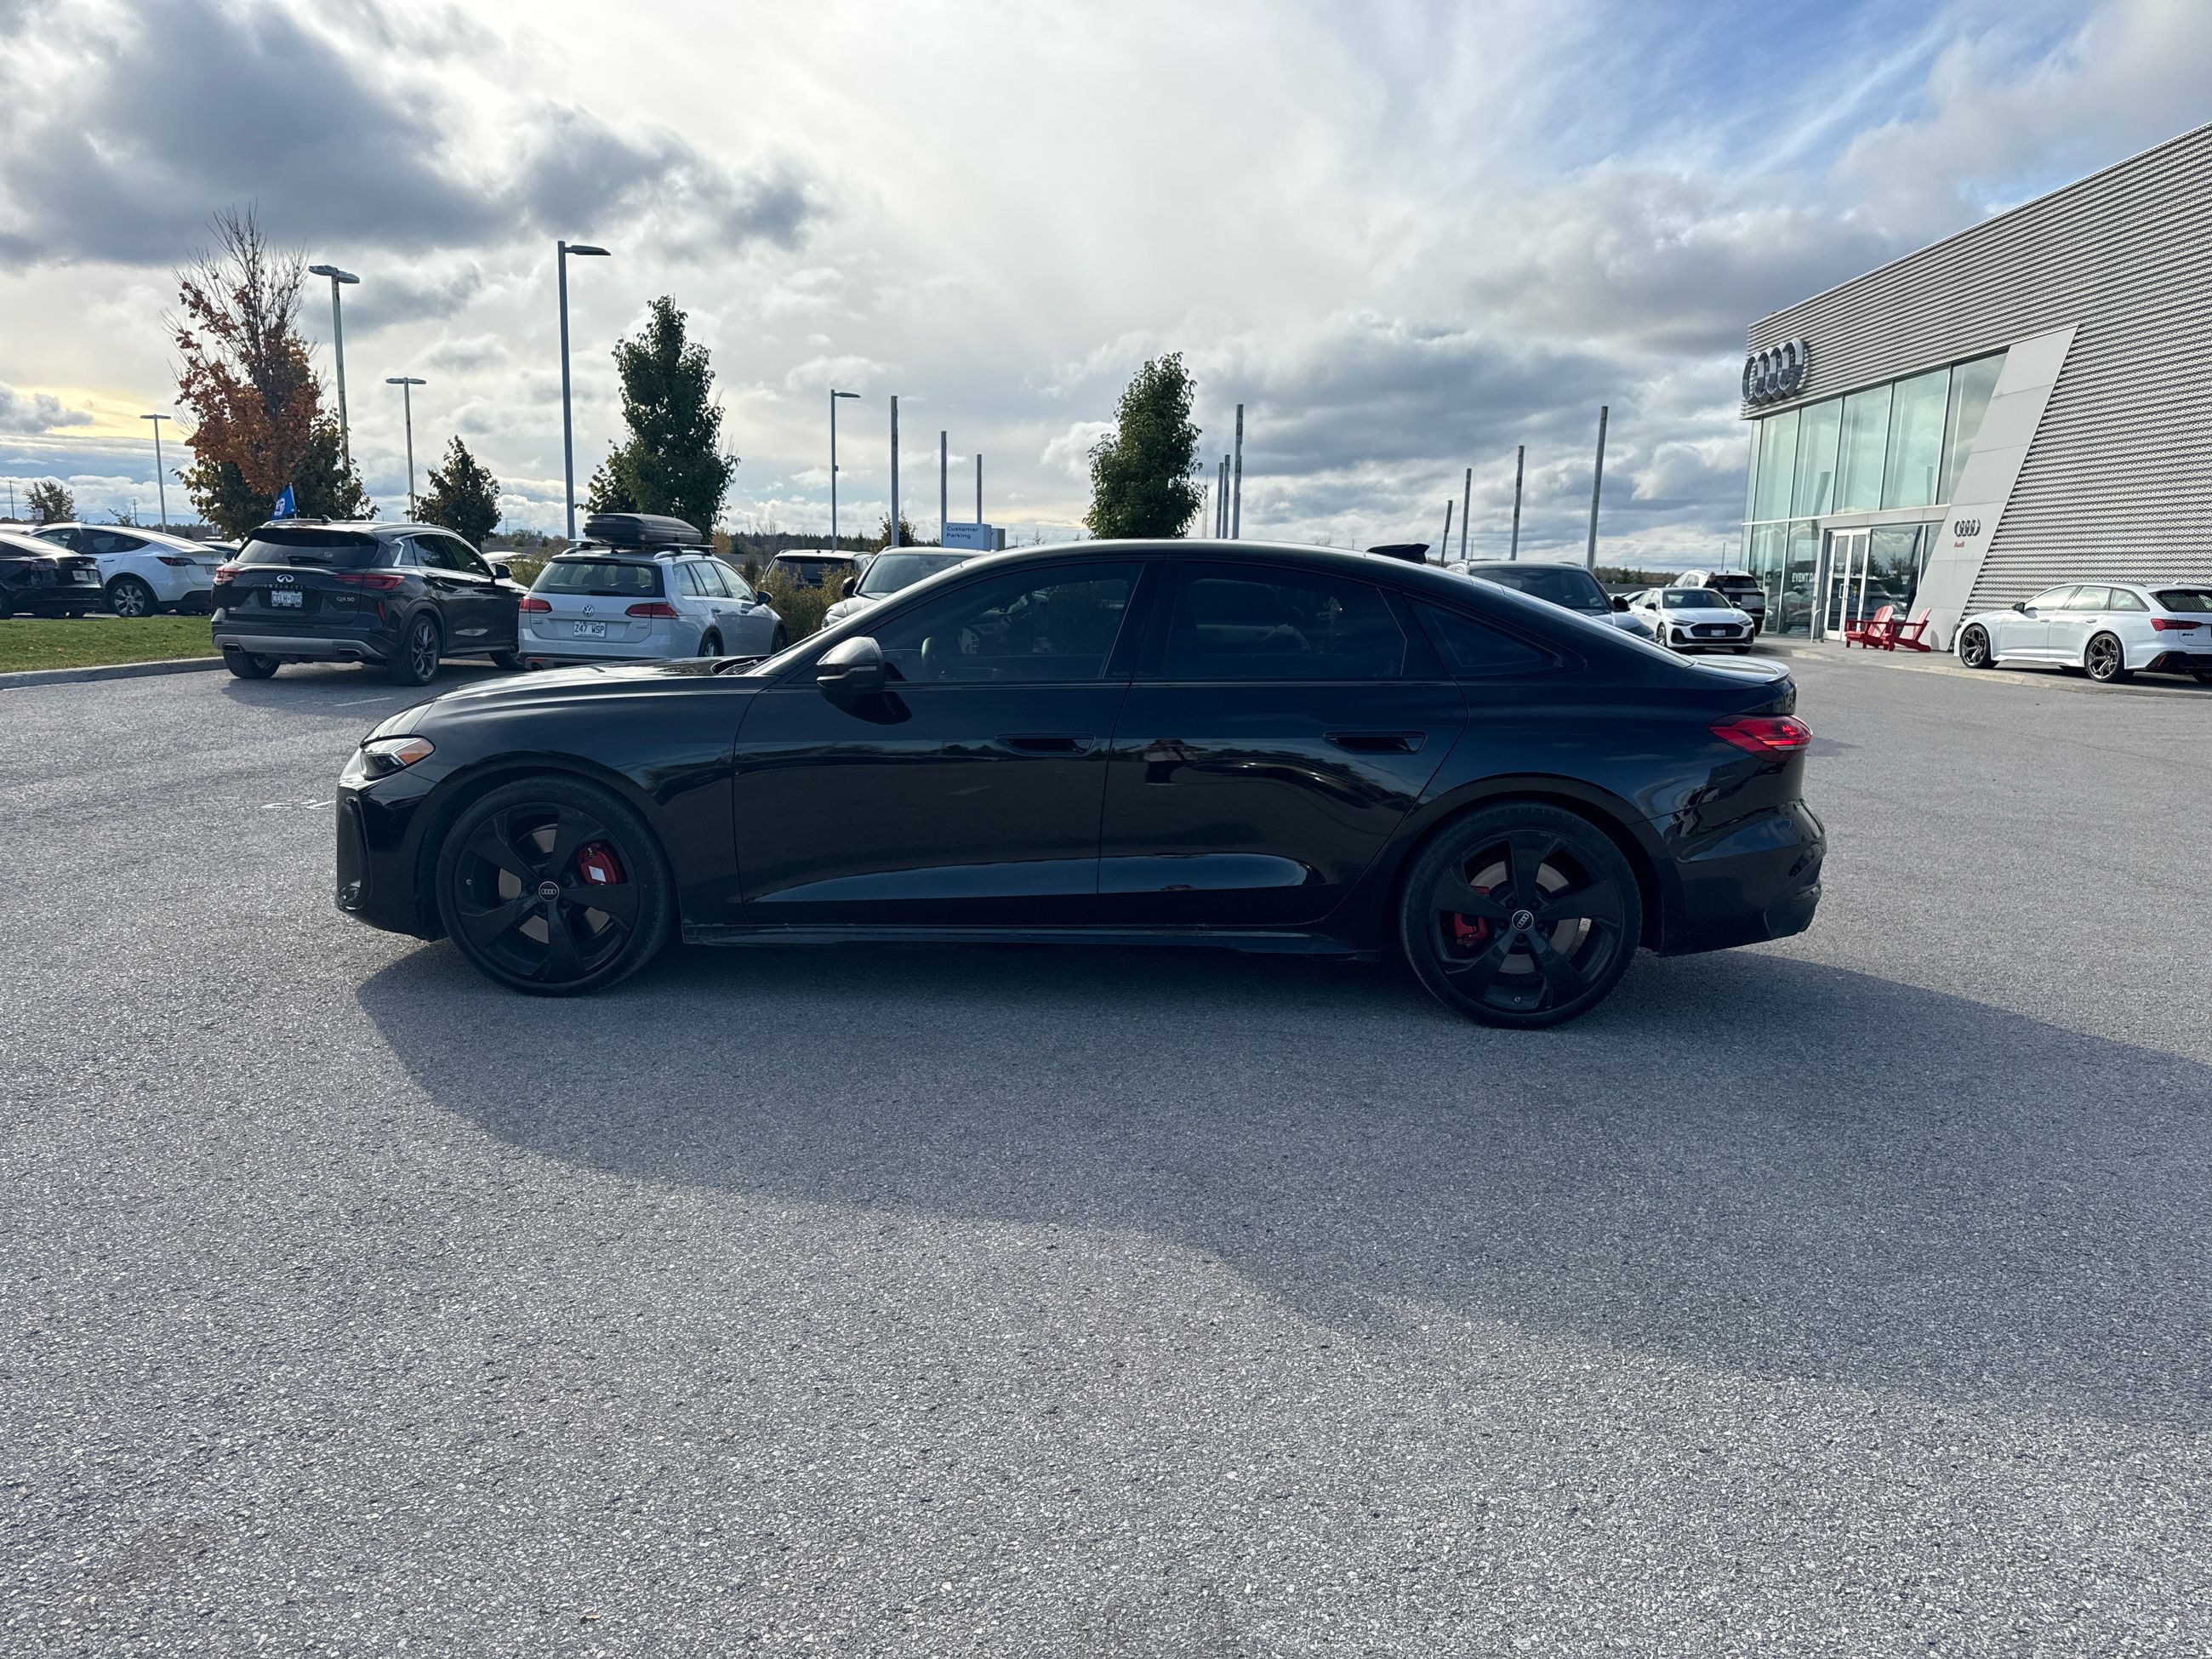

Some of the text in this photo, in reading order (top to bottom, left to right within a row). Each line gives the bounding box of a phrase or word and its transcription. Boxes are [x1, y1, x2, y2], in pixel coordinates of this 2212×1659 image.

[1791, 572, 1810, 583] EVENT
[574, 624, 605, 634] Z47 WSP
